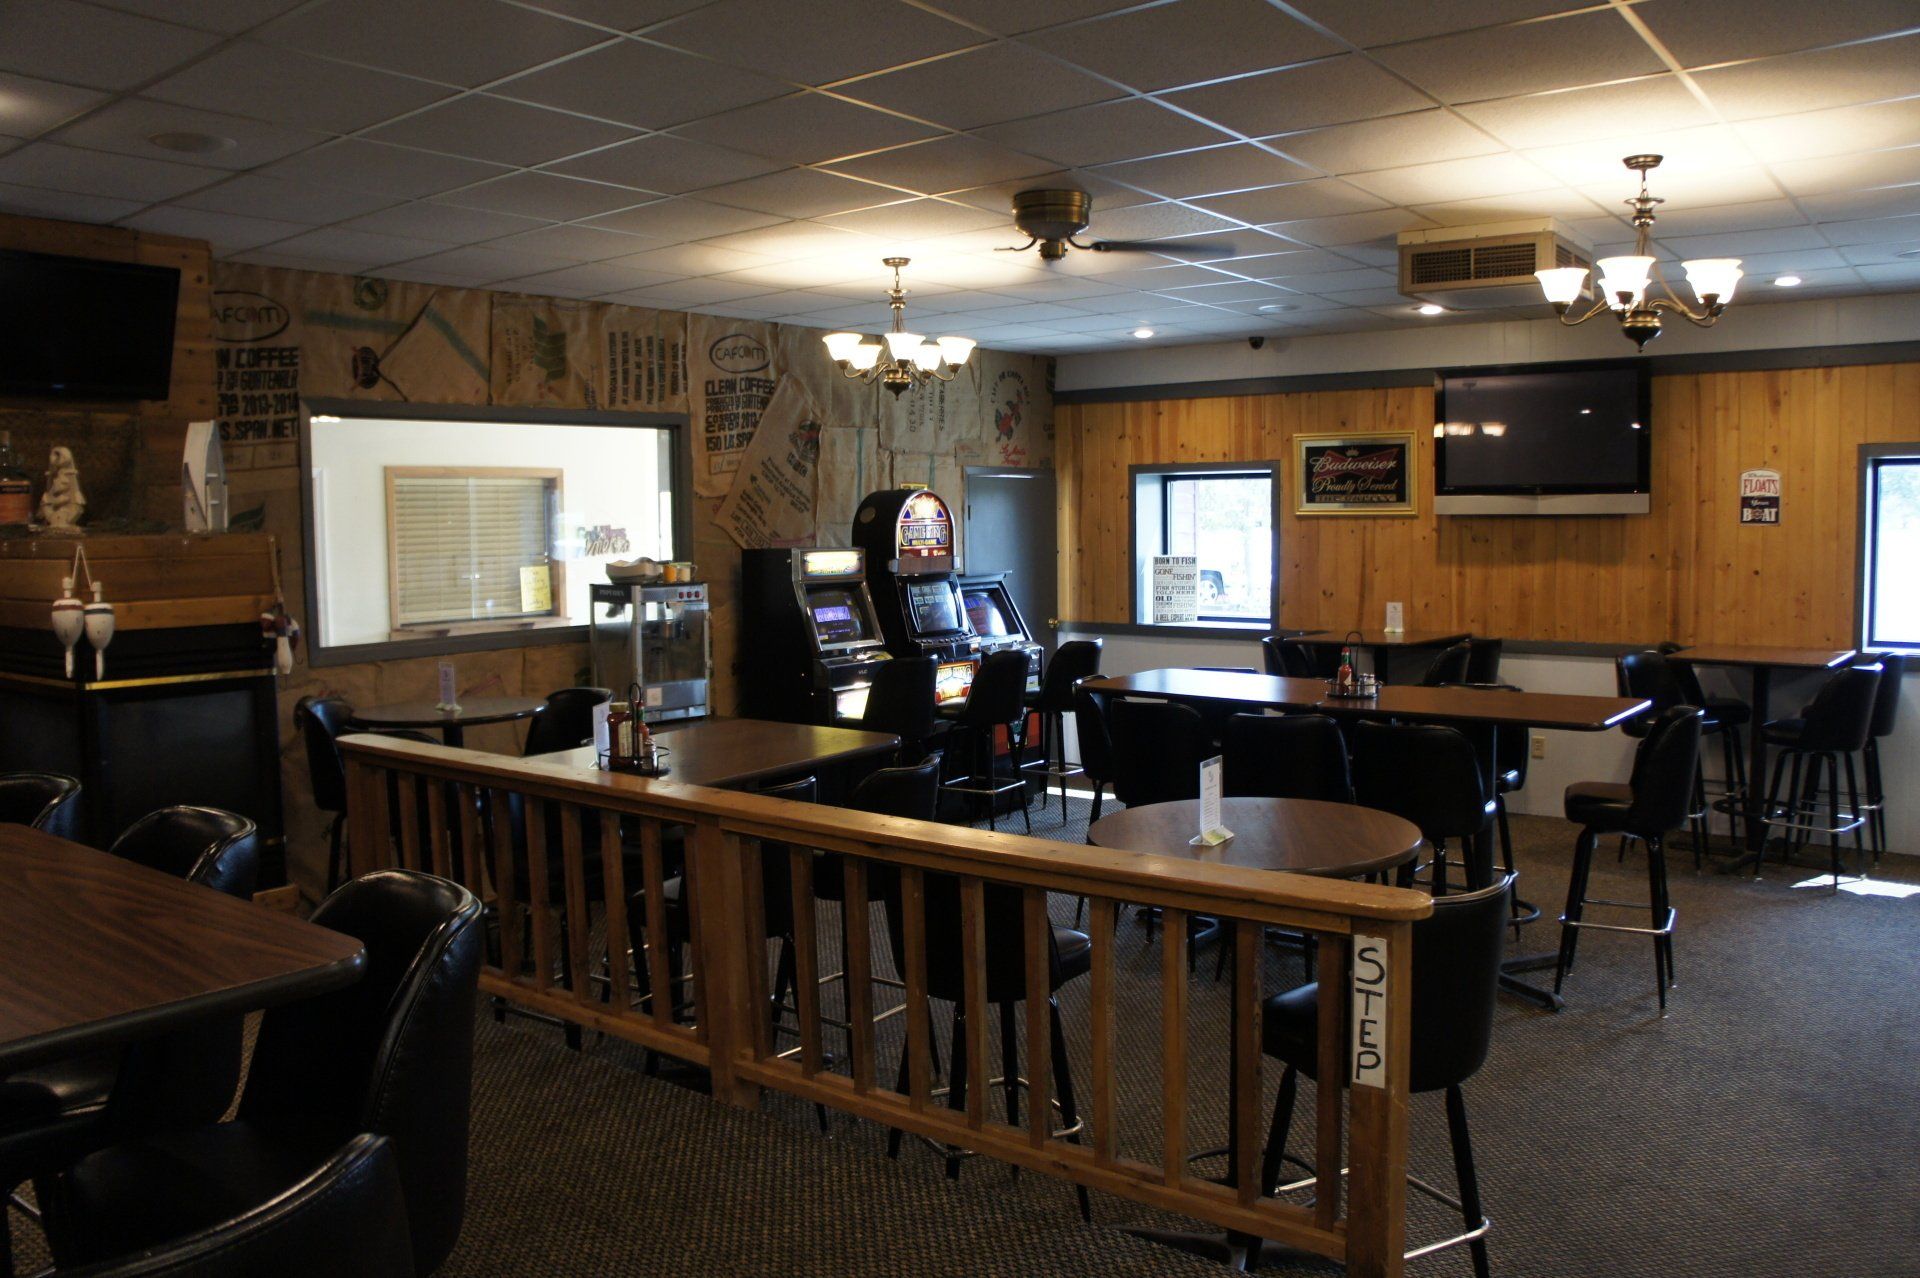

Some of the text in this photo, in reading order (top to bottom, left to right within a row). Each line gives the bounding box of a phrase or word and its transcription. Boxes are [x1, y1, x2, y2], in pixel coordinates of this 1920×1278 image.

[236, 347, 298, 368] COFFEE
[705, 377, 775, 396] CLEAN COFFEE
[1310, 456, 1398, 472] Budweiser
[1311, 475, 1399, 495] Proudly Served
[1743, 478, 1778, 494] FLOATS
[1742, 508, 1778, 521] BOAT
[901, 525, 947, 546] GAME KING
[1154, 557, 1196, 565] BORN TO FISH
[1355, 947, 1386, 1080] STEP
